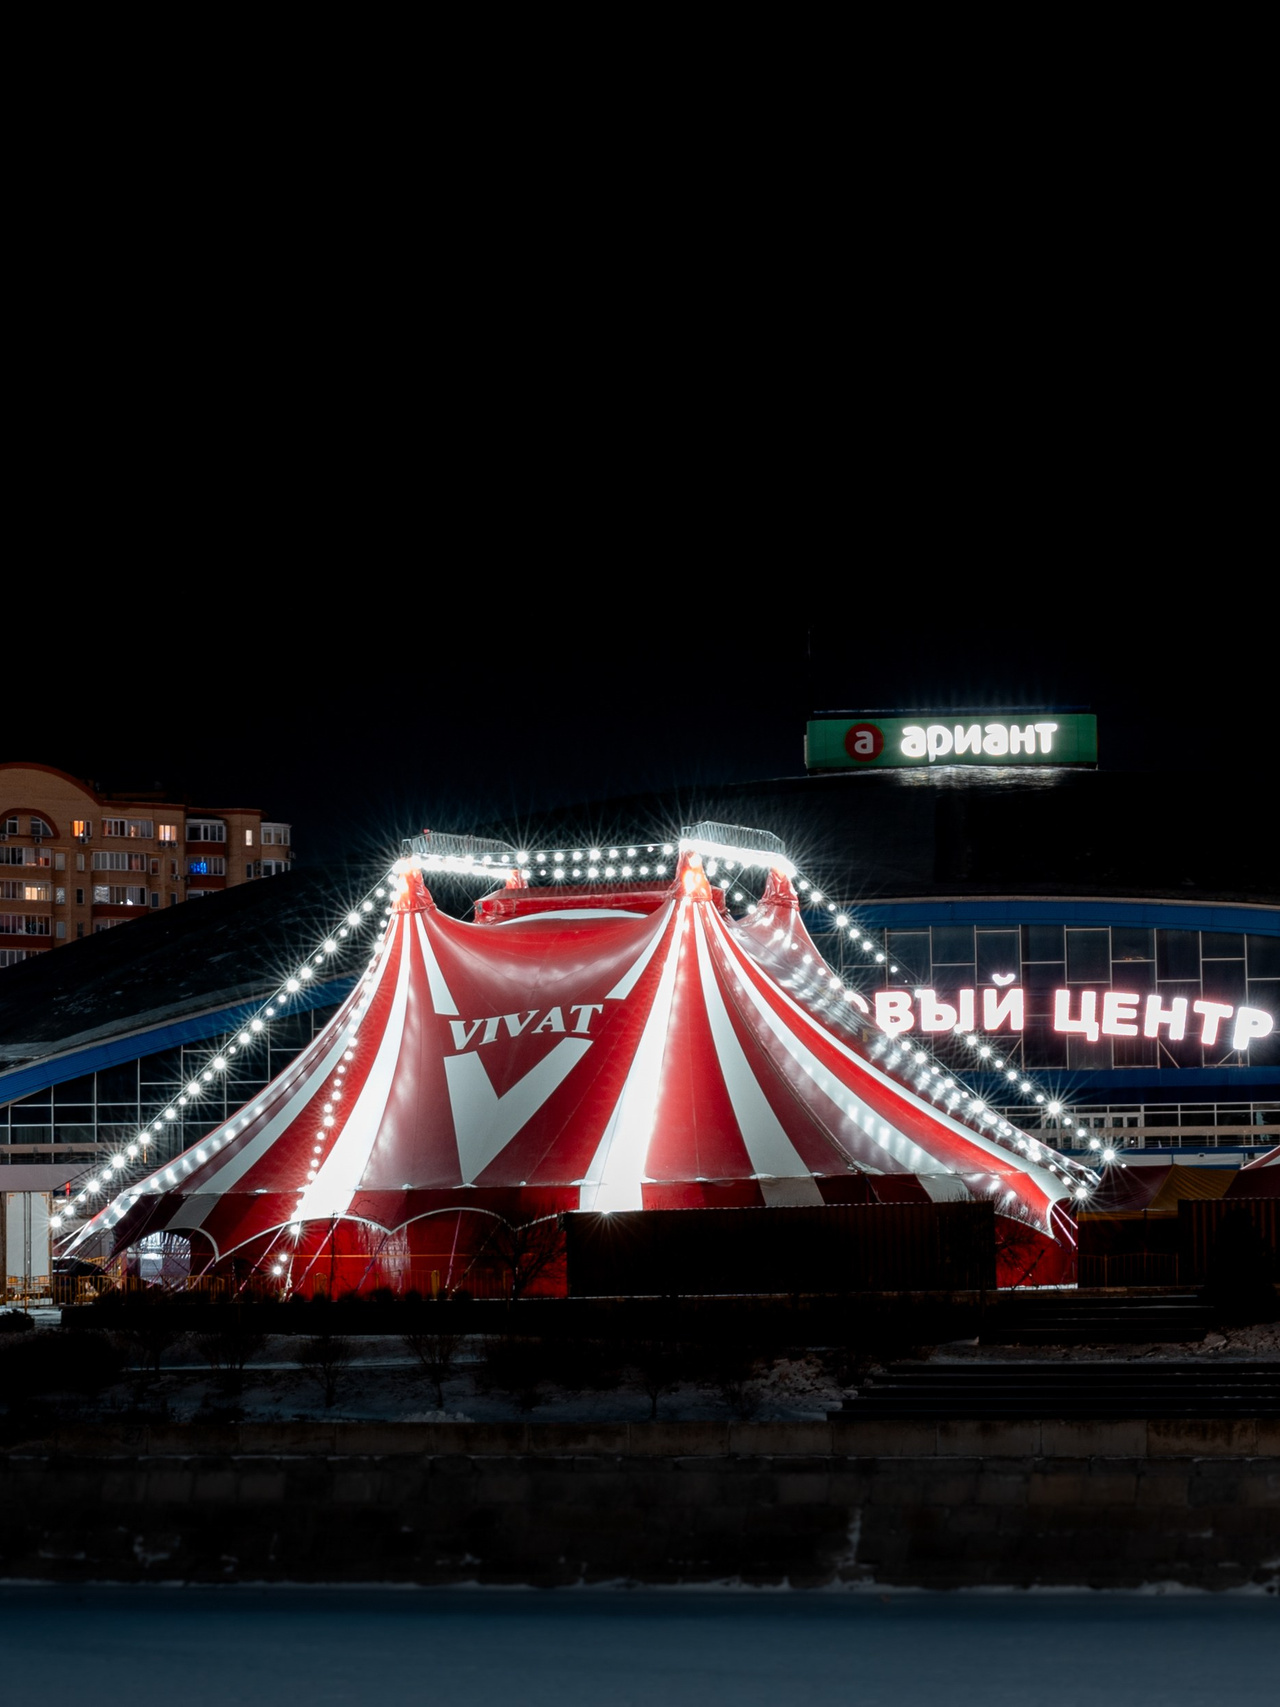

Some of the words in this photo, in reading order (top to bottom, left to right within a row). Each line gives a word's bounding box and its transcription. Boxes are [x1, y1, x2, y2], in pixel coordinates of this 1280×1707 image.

[900, 723, 1058, 763] ариант
[449, 1004, 603, 1050] VIVAT
[1054, 989, 1274, 1050] ЦЕНТР
